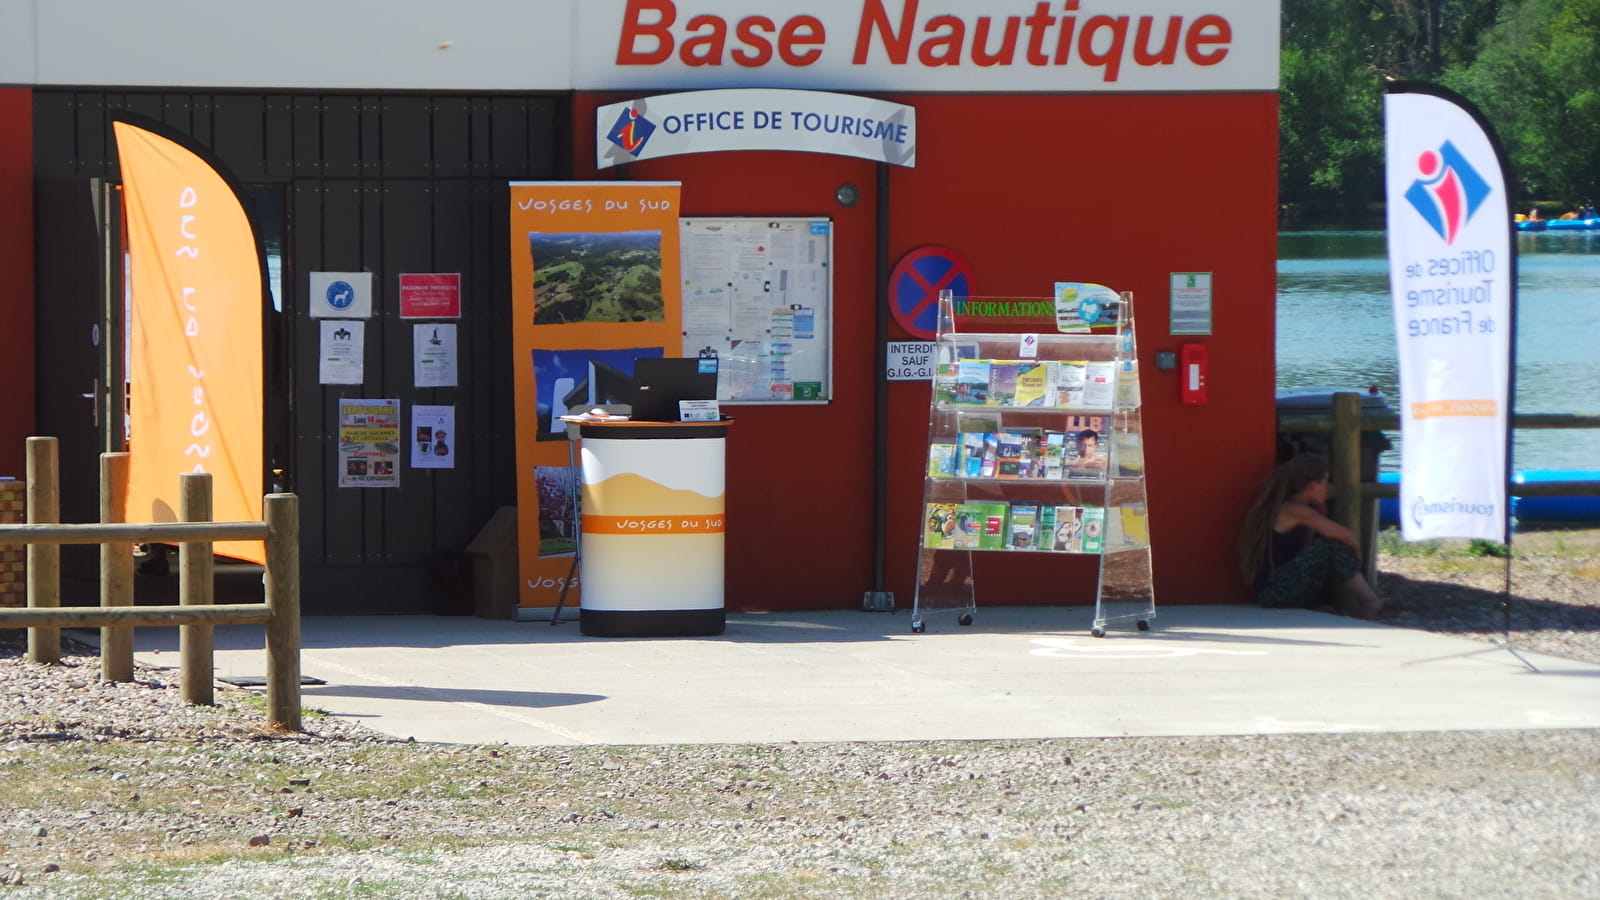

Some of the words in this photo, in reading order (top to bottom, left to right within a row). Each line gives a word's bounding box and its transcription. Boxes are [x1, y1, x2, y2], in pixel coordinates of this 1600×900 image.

[615, 0, 826, 67] Base
[852, 0, 1232, 82] Nautique
[663, 111, 744, 134] OFFICE
[753, 111, 782, 130] DE
[791, 111, 908, 144] TOURISME
[518, 198, 592, 214] VOSGES
[605, 200, 628, 210] DU
[639, 199, 671, 213] SUD
[956, 301, 1056, 317] INFORMATIONS
[902, 356, 929, 366] SAUF
[888, 368, 934, 377] G.I.G.-G.I.
[616, 520, 672, 532] VOSGES
[681, 520, 698, 528] DU
[705, 519, 722, 529] SUD
[527, 576, 578, 592] VOSG
